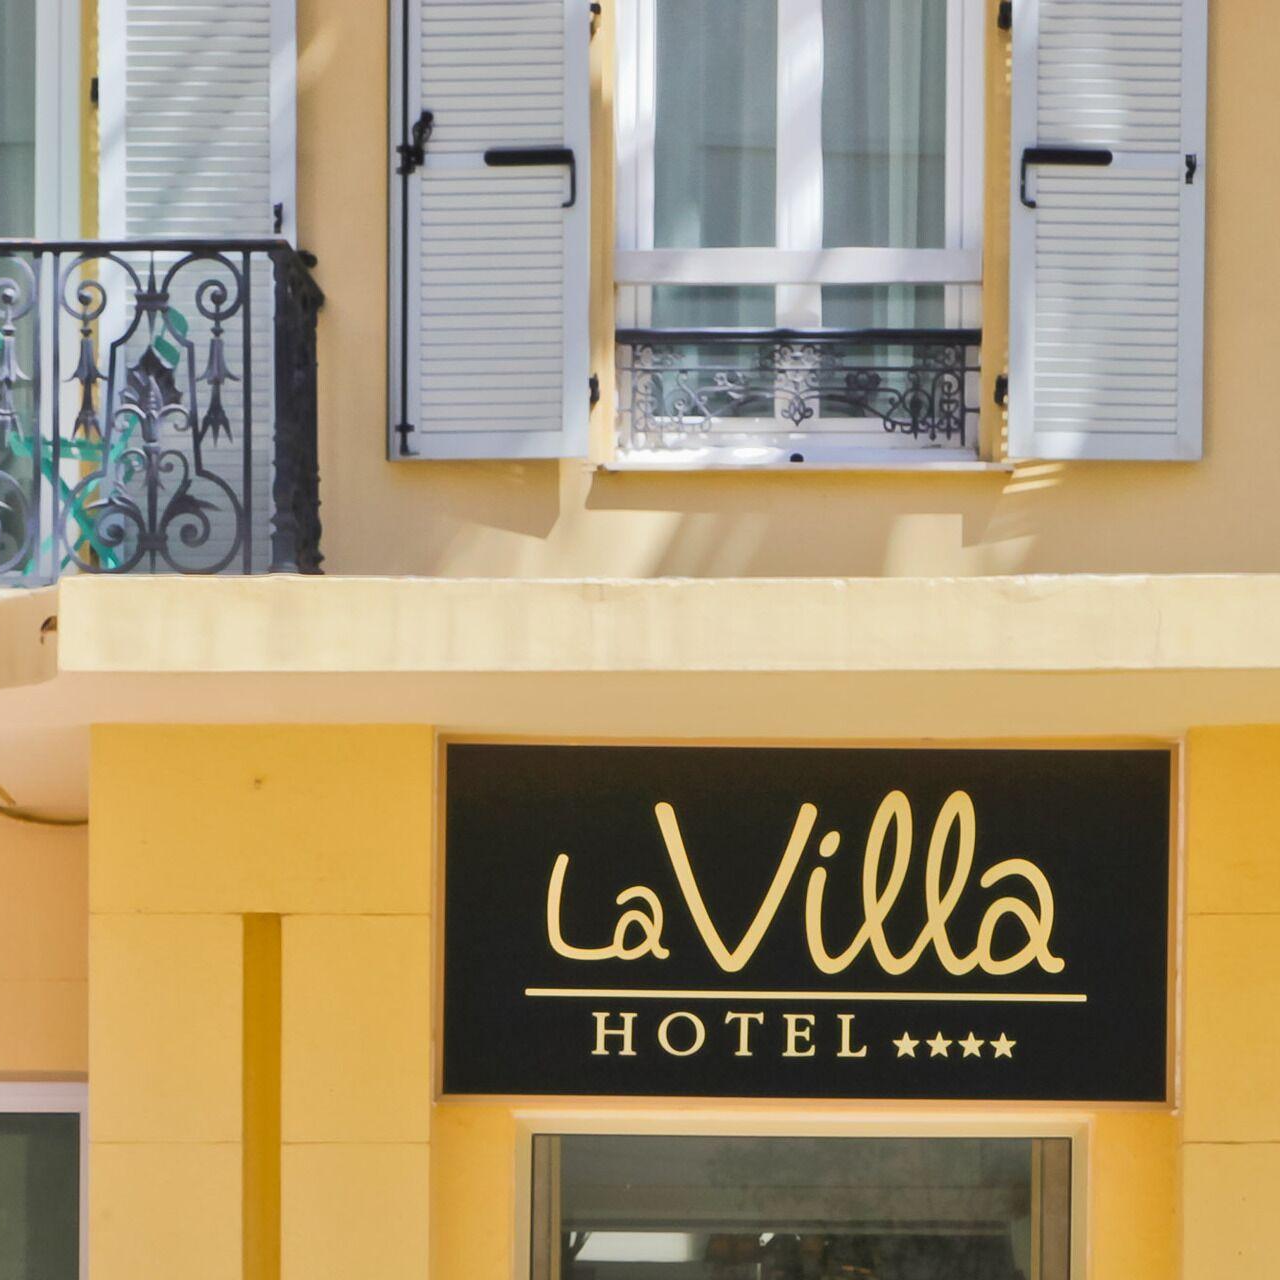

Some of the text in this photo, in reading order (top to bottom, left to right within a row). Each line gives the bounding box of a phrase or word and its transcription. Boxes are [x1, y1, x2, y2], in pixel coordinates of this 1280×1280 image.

[547, 790, 1065, 975] La Villa
[591, 1011, 868, 1058] HOTEL
